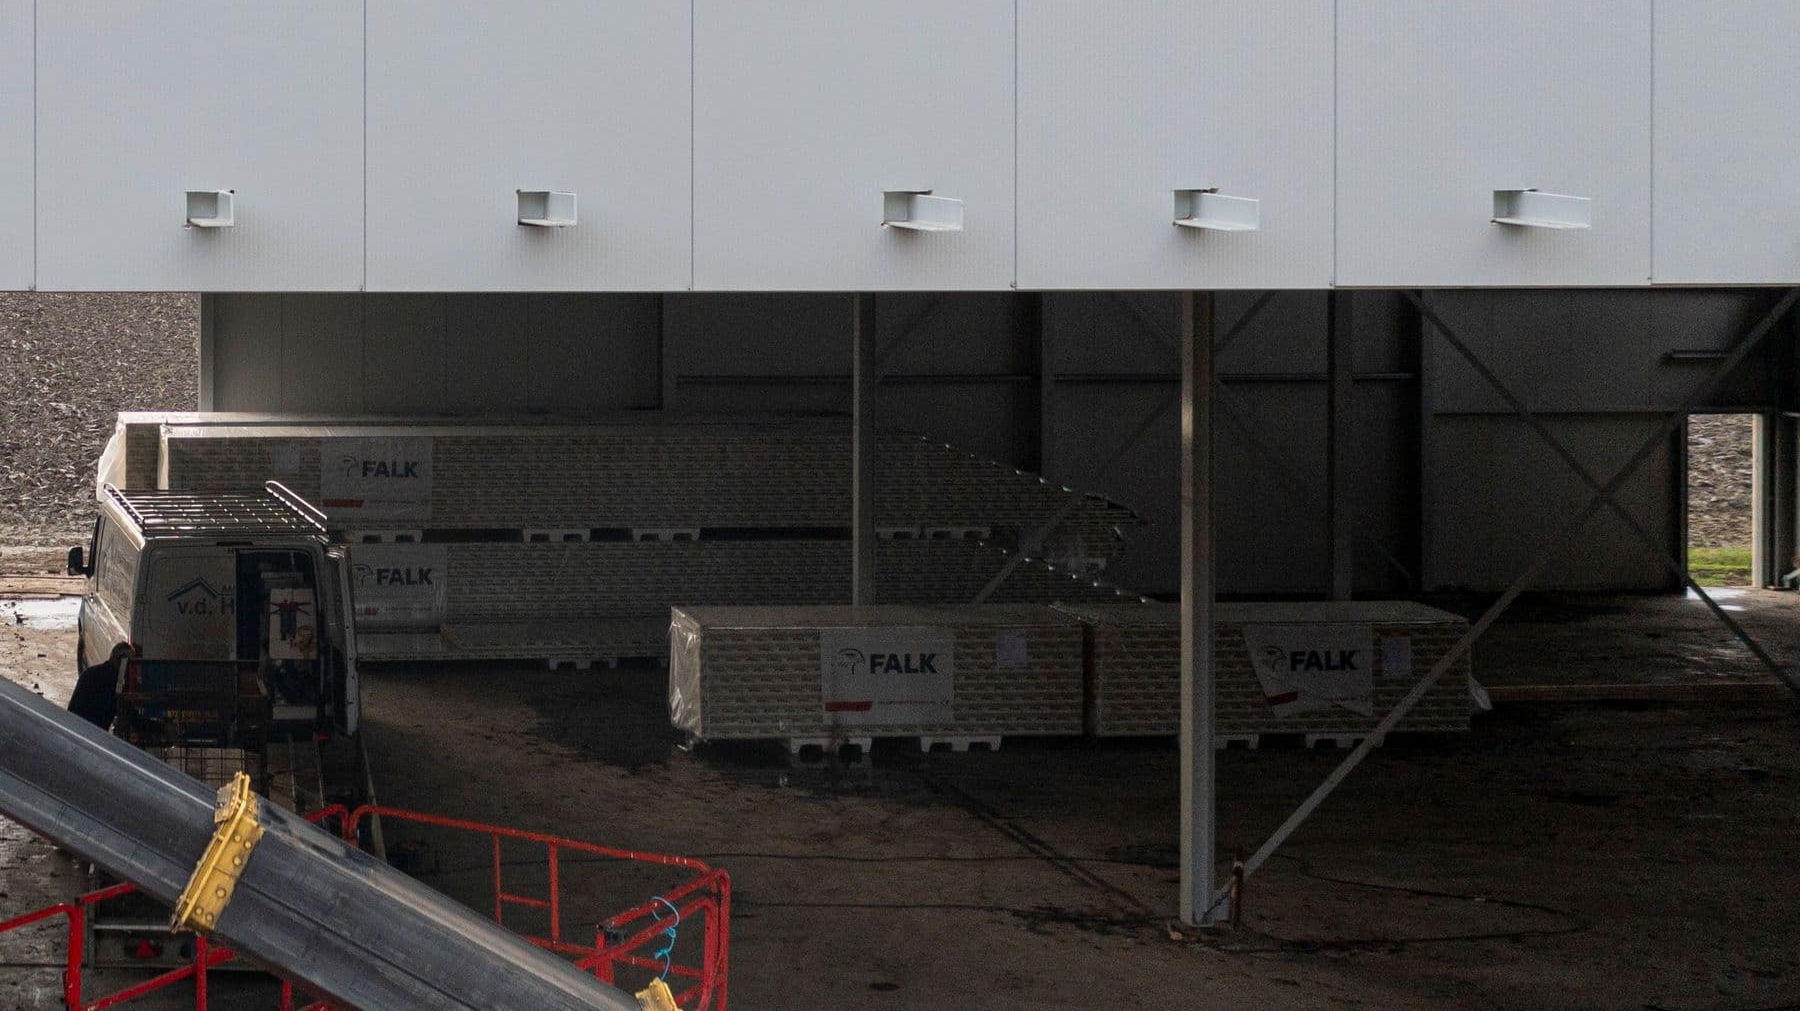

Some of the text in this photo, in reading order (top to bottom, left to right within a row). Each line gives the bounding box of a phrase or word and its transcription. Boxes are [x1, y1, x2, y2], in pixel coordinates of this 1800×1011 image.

[361, 460, 420, 479] FALK
[376, 568, 433, 586] FALK
[176, 597, 212, 615] v.d.
[869, 652, 938, 675] FALK
[1289, 649, 1358, 672] FALK
